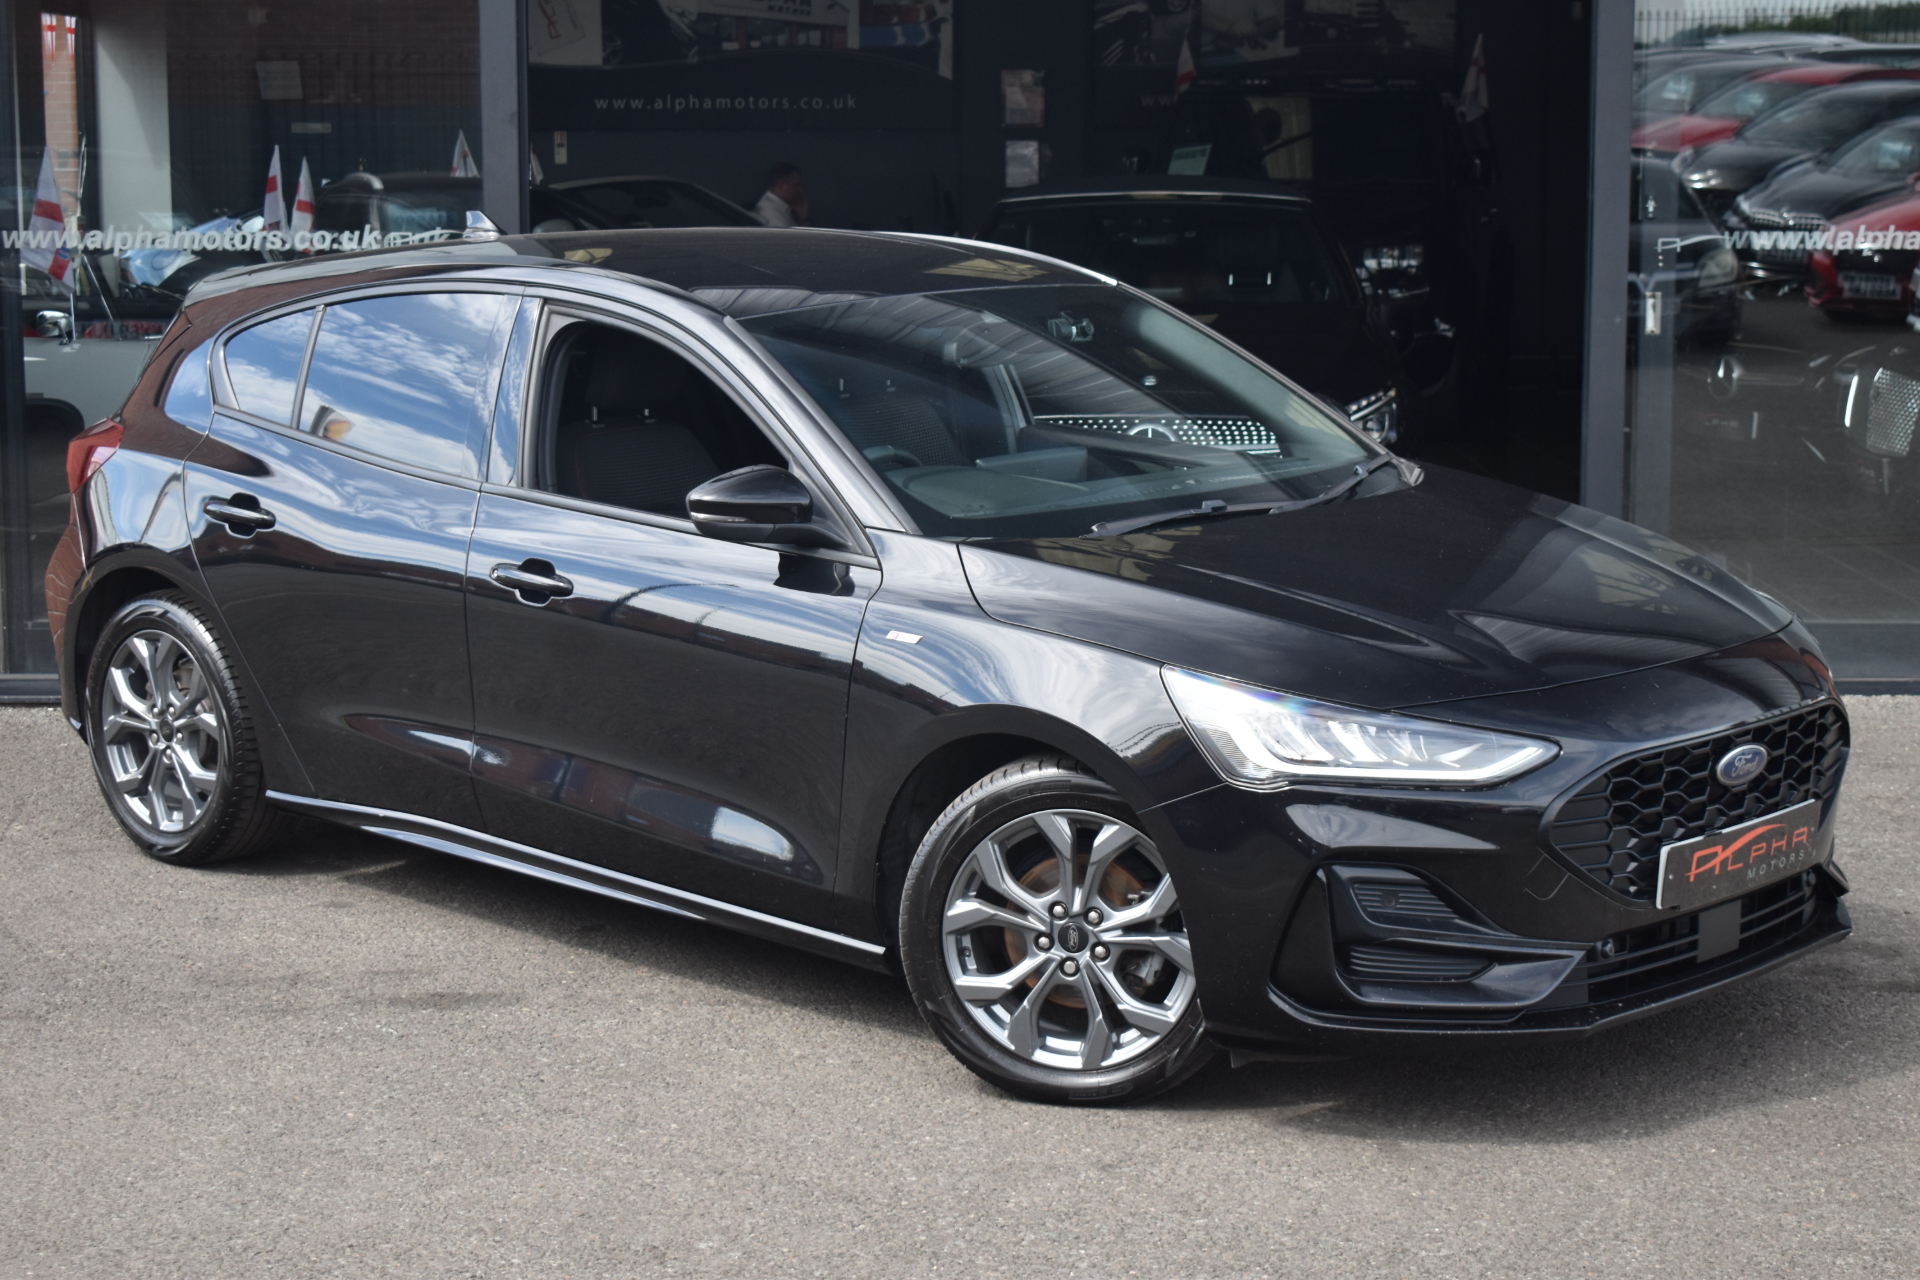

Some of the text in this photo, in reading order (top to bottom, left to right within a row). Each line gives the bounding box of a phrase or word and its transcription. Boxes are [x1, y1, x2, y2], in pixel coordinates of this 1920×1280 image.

[594, 93, 858, 112] www.alphamotors.co.uk
[2, 224, 384, 256] www.alphamotors.co.uk
[1685, 824, 1808, 882] ALPHA
[1747, 849, 1805, 880] MOTORS
